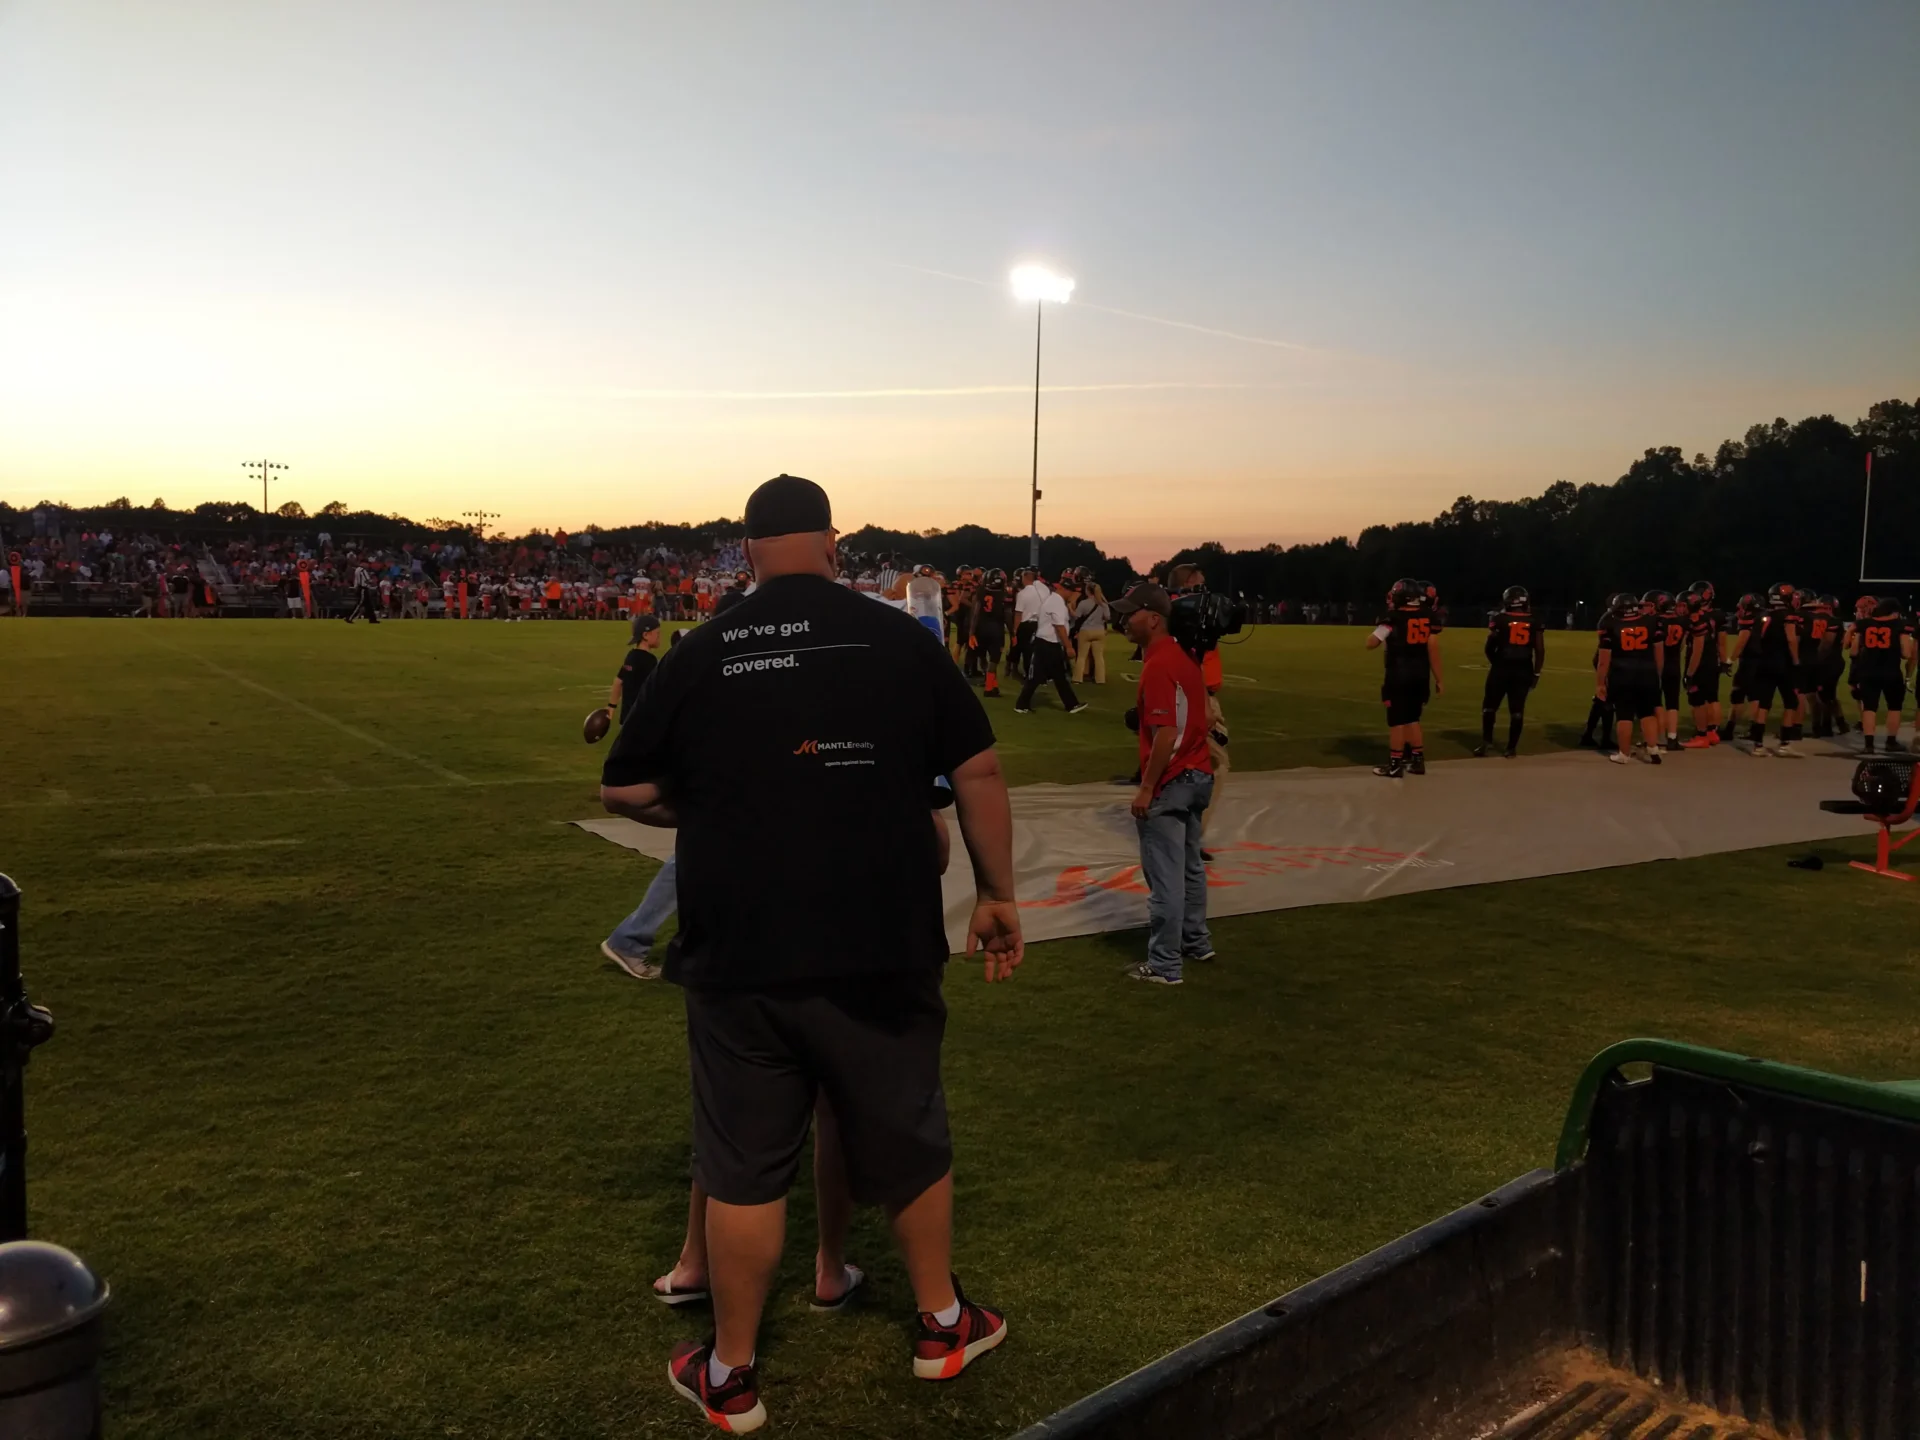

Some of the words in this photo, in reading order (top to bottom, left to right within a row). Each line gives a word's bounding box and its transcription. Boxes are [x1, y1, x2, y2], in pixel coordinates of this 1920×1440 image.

[722, 624, 776, 643] We've
[780, 620, 810, 636] got
[1406, 618, 1430, 644] 65
[1508, 621, 1530, 645] 15
[1620, 627, 1648, 650] 62
[1864, 627, 1891, 649] 63
[722, 654, 800, 676] covered.
